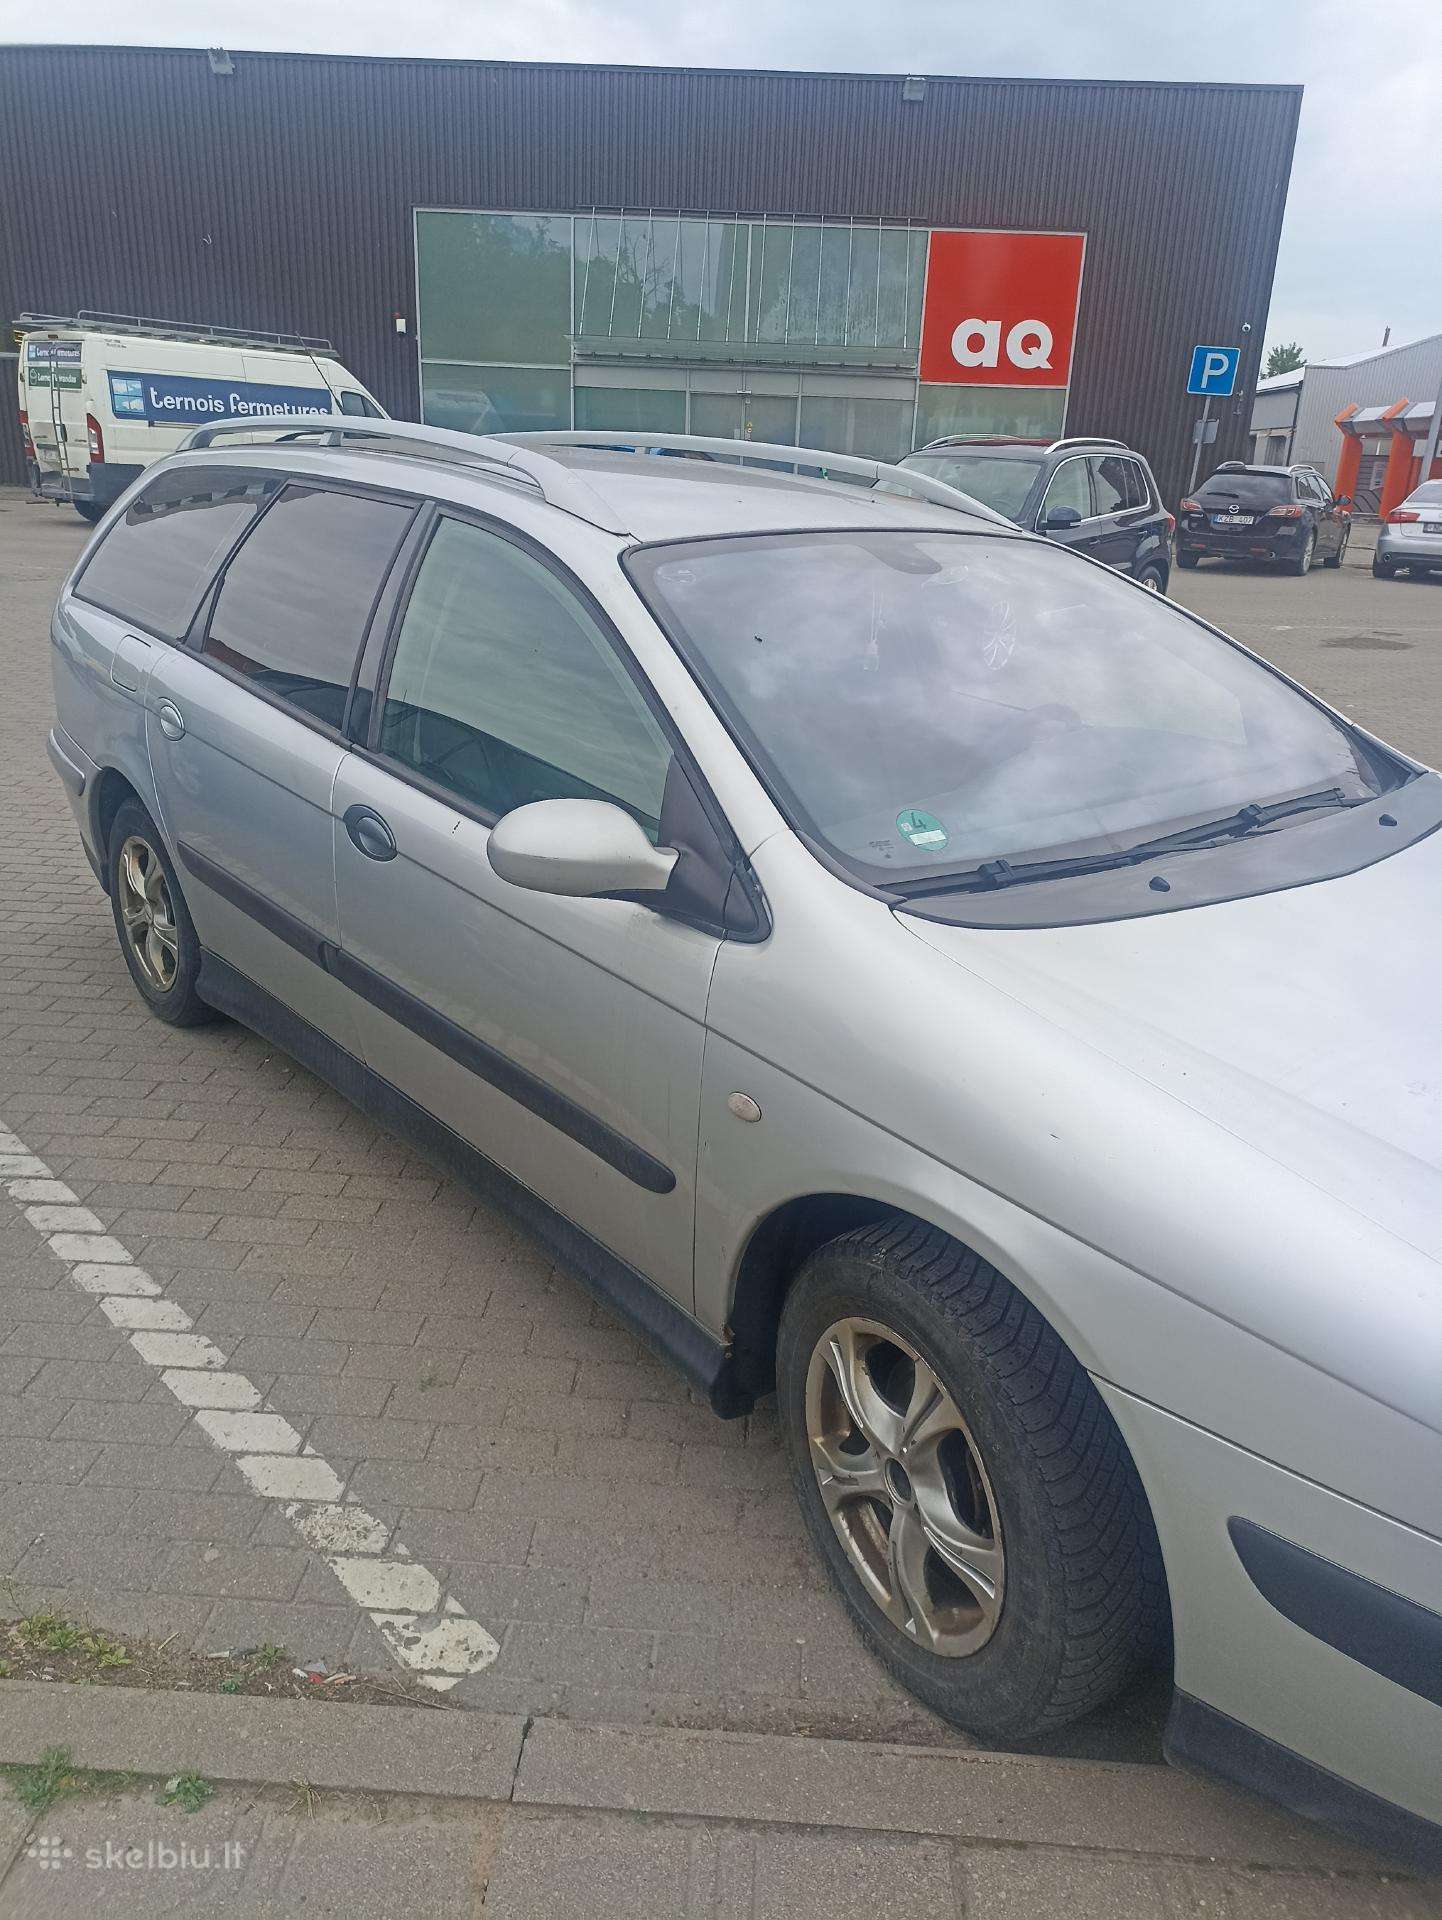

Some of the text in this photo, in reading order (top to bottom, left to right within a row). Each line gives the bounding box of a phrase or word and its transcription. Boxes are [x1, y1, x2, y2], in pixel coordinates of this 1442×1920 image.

[1200, 352, 1229, 389] P
[150, 387, 329, 416] ternois fermetures
[911, 811, 927, 830] 4
